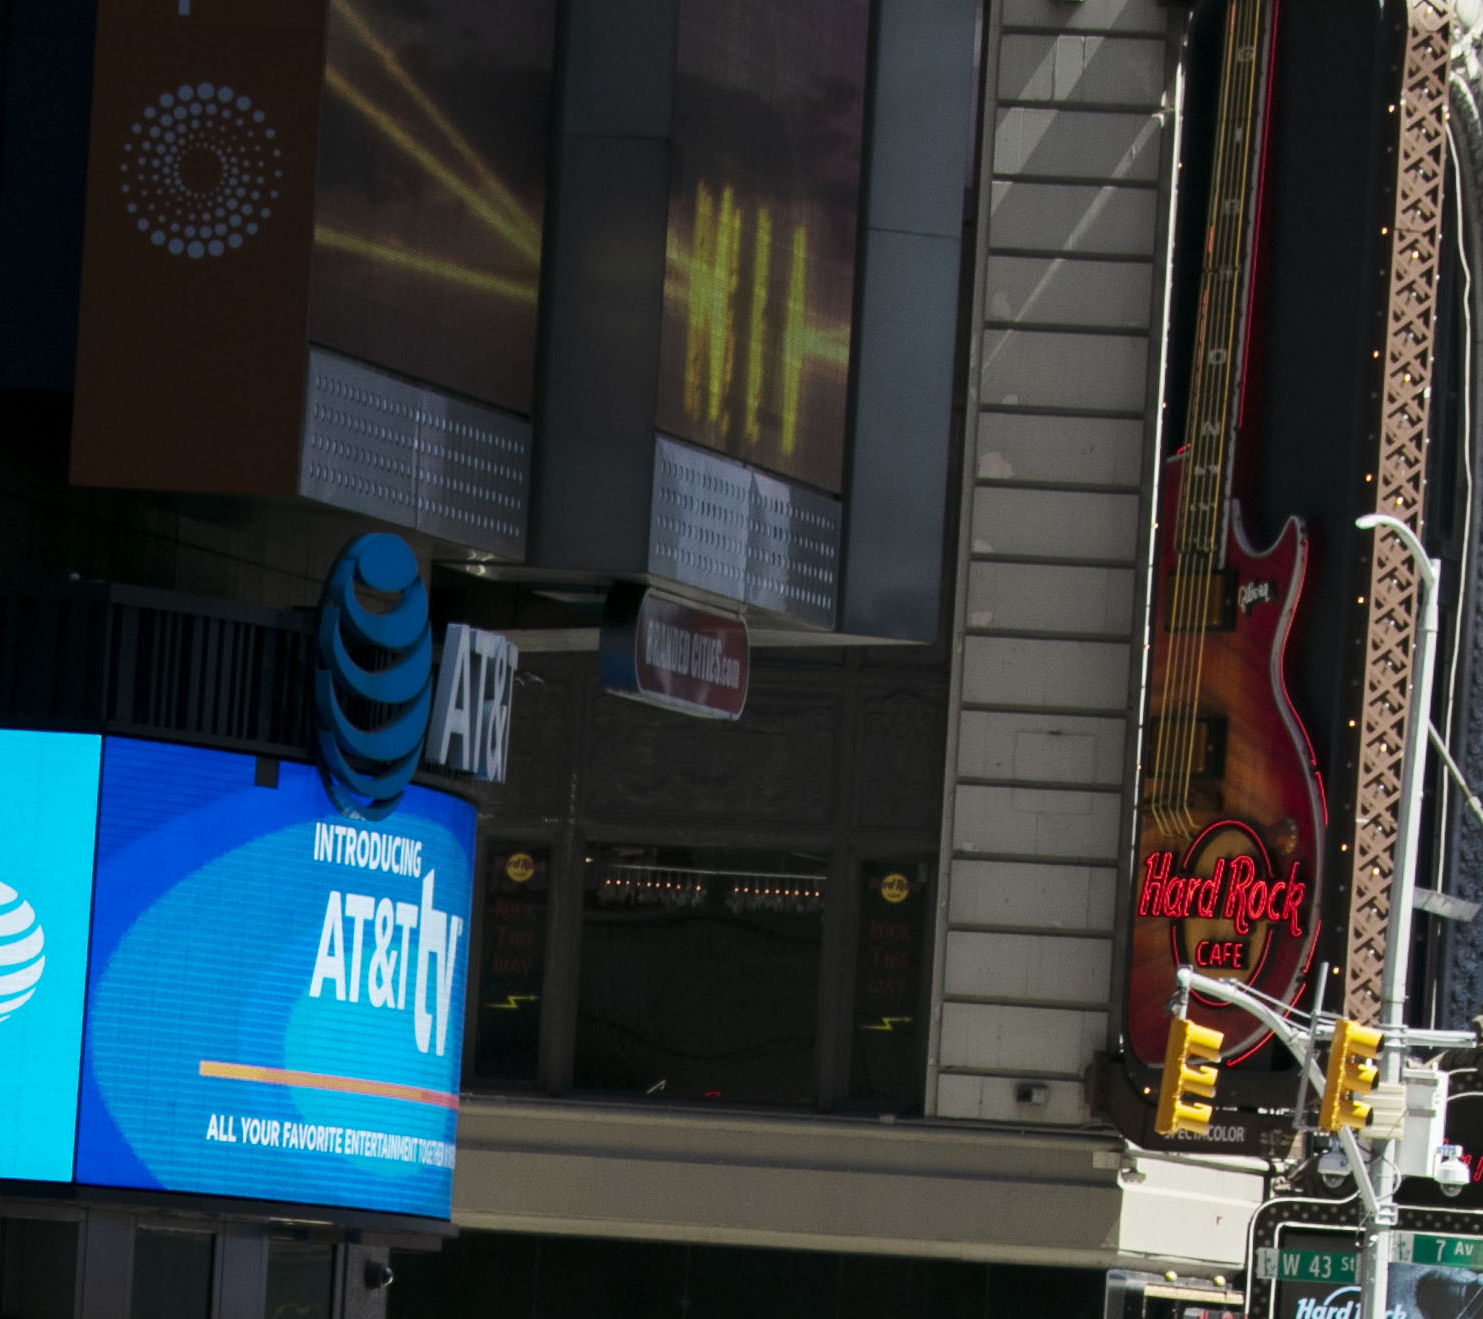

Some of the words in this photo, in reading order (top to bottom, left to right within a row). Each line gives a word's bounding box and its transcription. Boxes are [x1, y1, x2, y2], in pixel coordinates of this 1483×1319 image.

[440, 624, 517, 783] AT&T
[313, 822, 423, 878] INTRODUCING
[1138, 852, 1225, 918] Hard
[1223, 855, 1307, 938] Rock
[309, 890, 419, 1010] AT&T
[1195, 941, 1243, 968] CAFE
[206, 1114, 237, 1143] ALL
[241, 1116, 280, 1147] YOUR
[283, 1123, 343, 1153] FAVORITE
[344, 1129, 419, 1162] ENTERTAINMENT
[1283, 1256, 1302, 1276] W
[1308, 1256, 1333, 1279] 43
[1340, 1257, 1356, 1272] St
[1435, 1239, 1448, 1262] 7
[1453, 1241, 1475, 1257] Av
